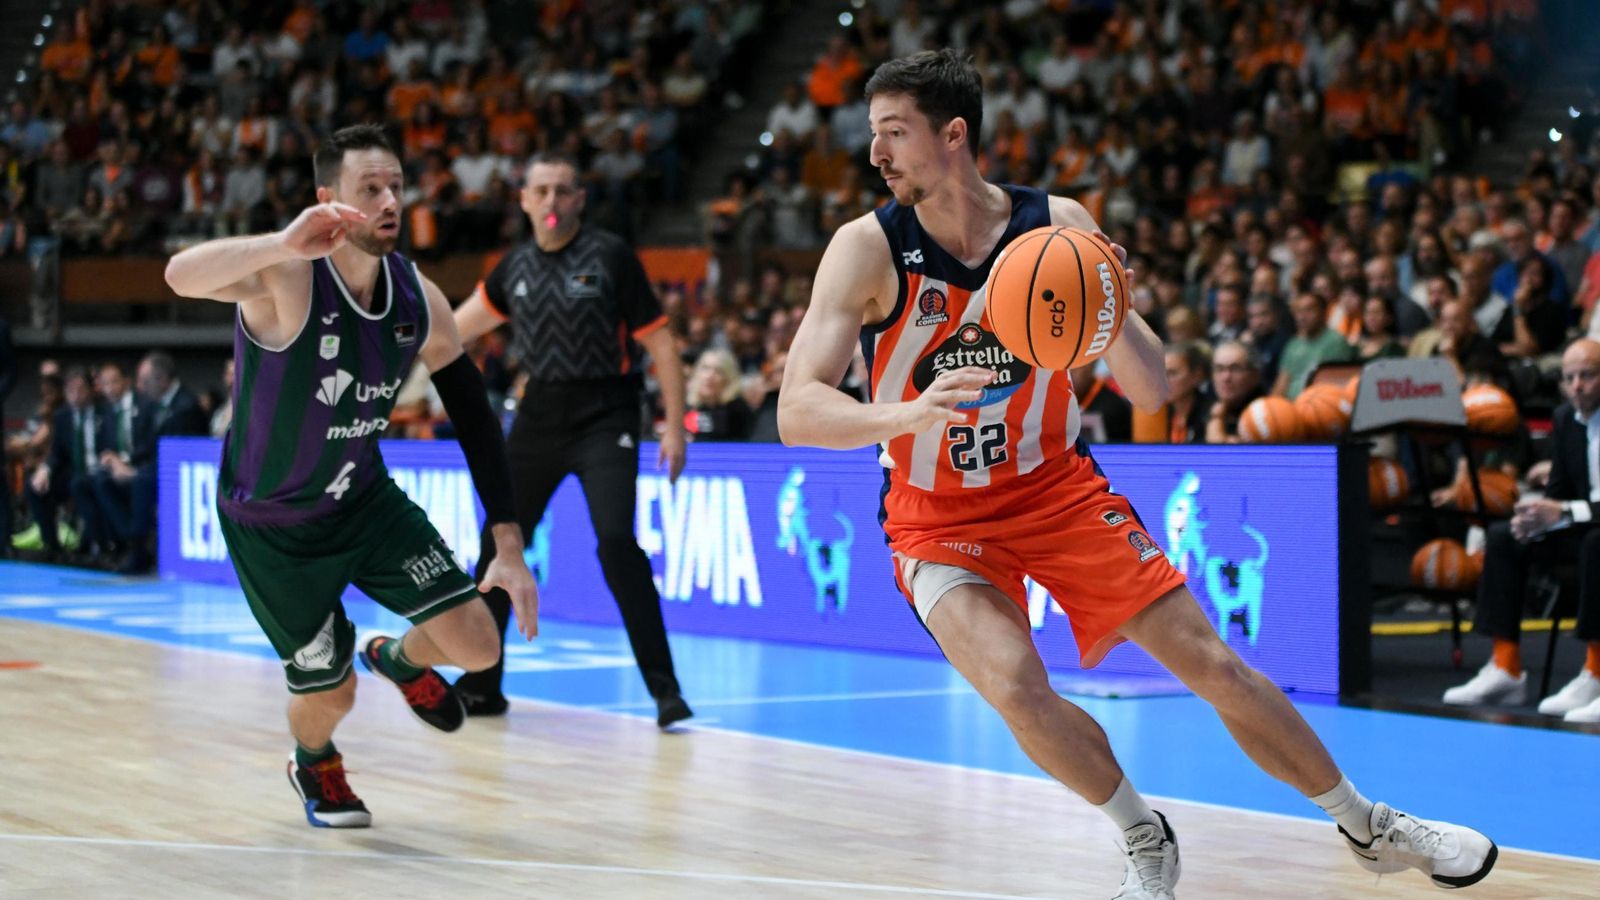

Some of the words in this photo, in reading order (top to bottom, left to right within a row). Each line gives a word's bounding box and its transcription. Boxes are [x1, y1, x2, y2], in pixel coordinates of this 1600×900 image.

[1050, 300, 1066, 337] acb
[1084, 261, 1116, 357] Wilson
[931, 346, 1015, 371] Estrella
[1376, 376, 1444, 401] Wilson
[947, 423, 1008, 471] 22
[325, 461, 356, 500] 4
[636, 475, 762, 606] EYMA
